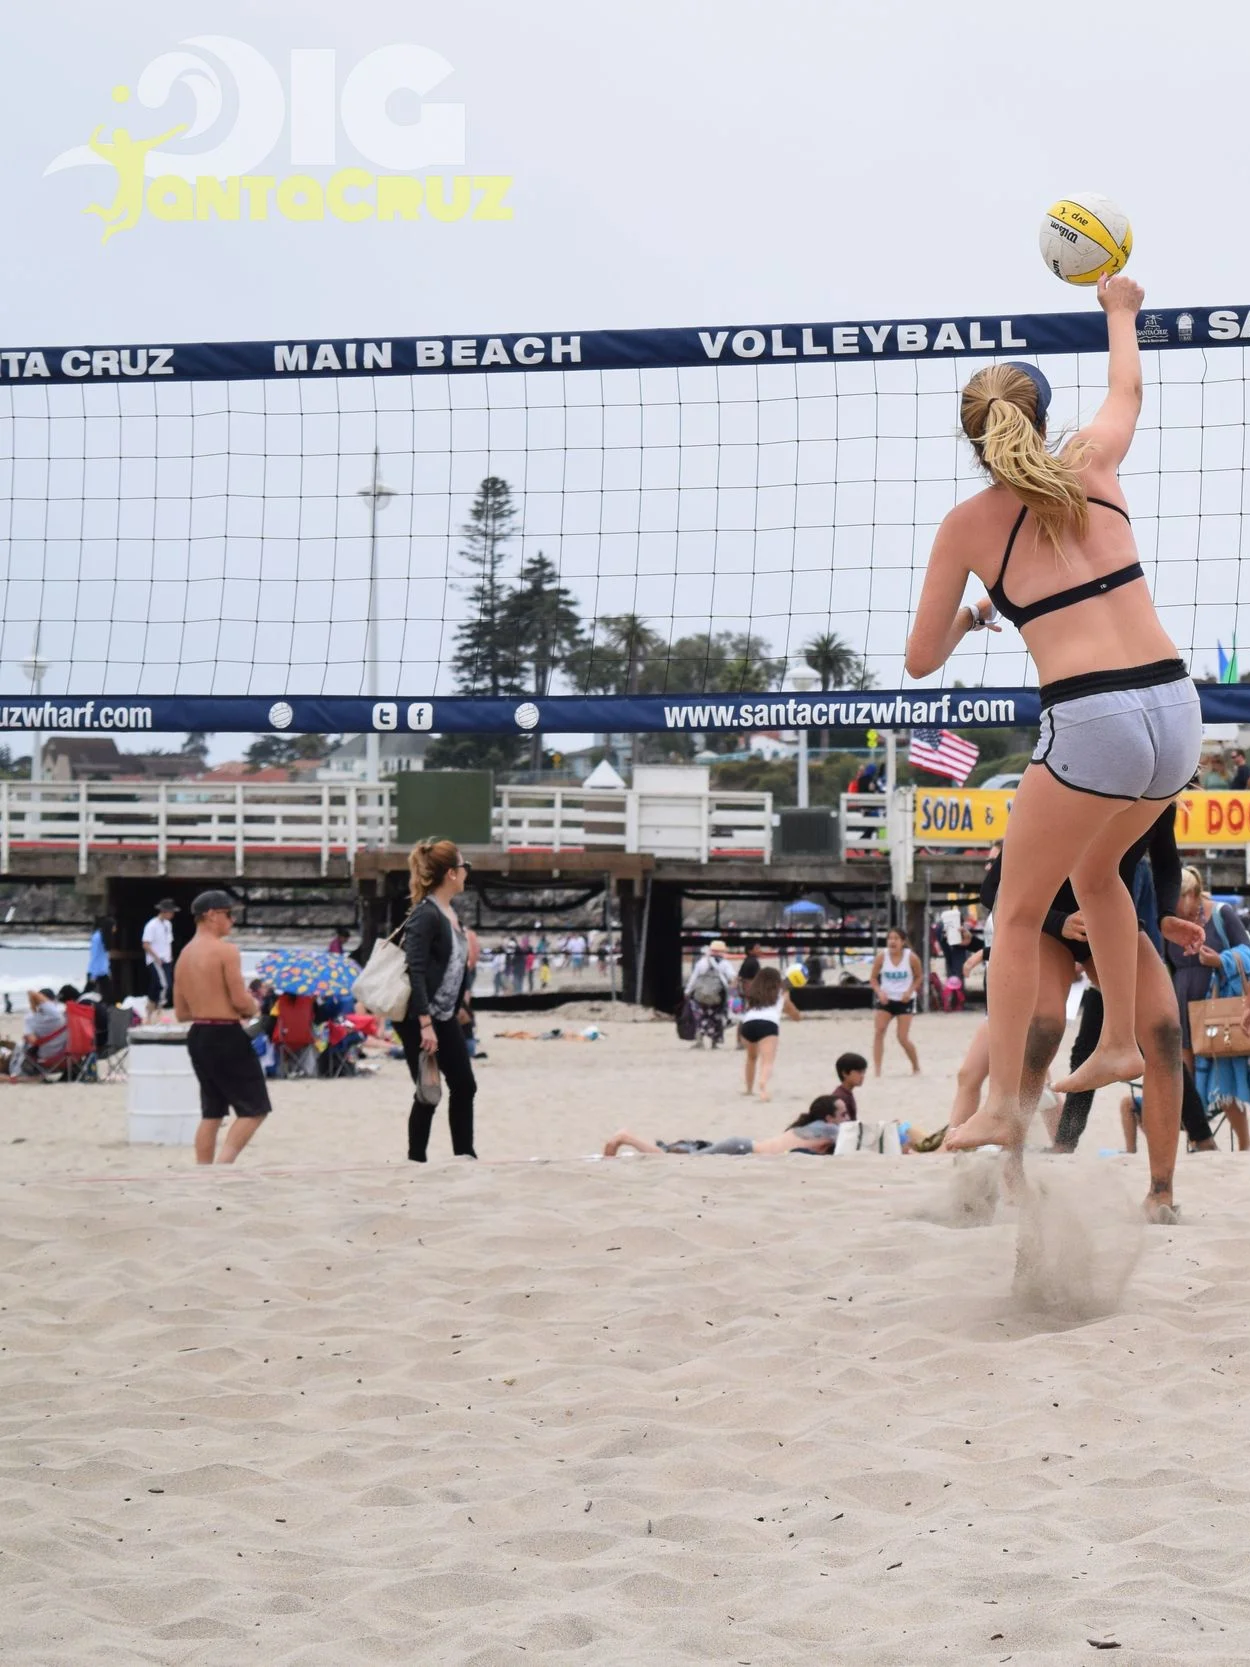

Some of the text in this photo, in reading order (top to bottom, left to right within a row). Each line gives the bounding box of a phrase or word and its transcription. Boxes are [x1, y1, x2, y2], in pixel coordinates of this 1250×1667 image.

[1050, 220, 1079, 244] Wilson
[273, 336, 582, 372] MAIN BEACH
[698, 320, 1027, 359] VOLLEYBALL
[0, 349, 175, 378] TA CRUZ
[664, 696, 1016, 728] www.santacruzwharf.com
[921, 797, 974, 831] SODA
[984, 806, 995, 825] &
